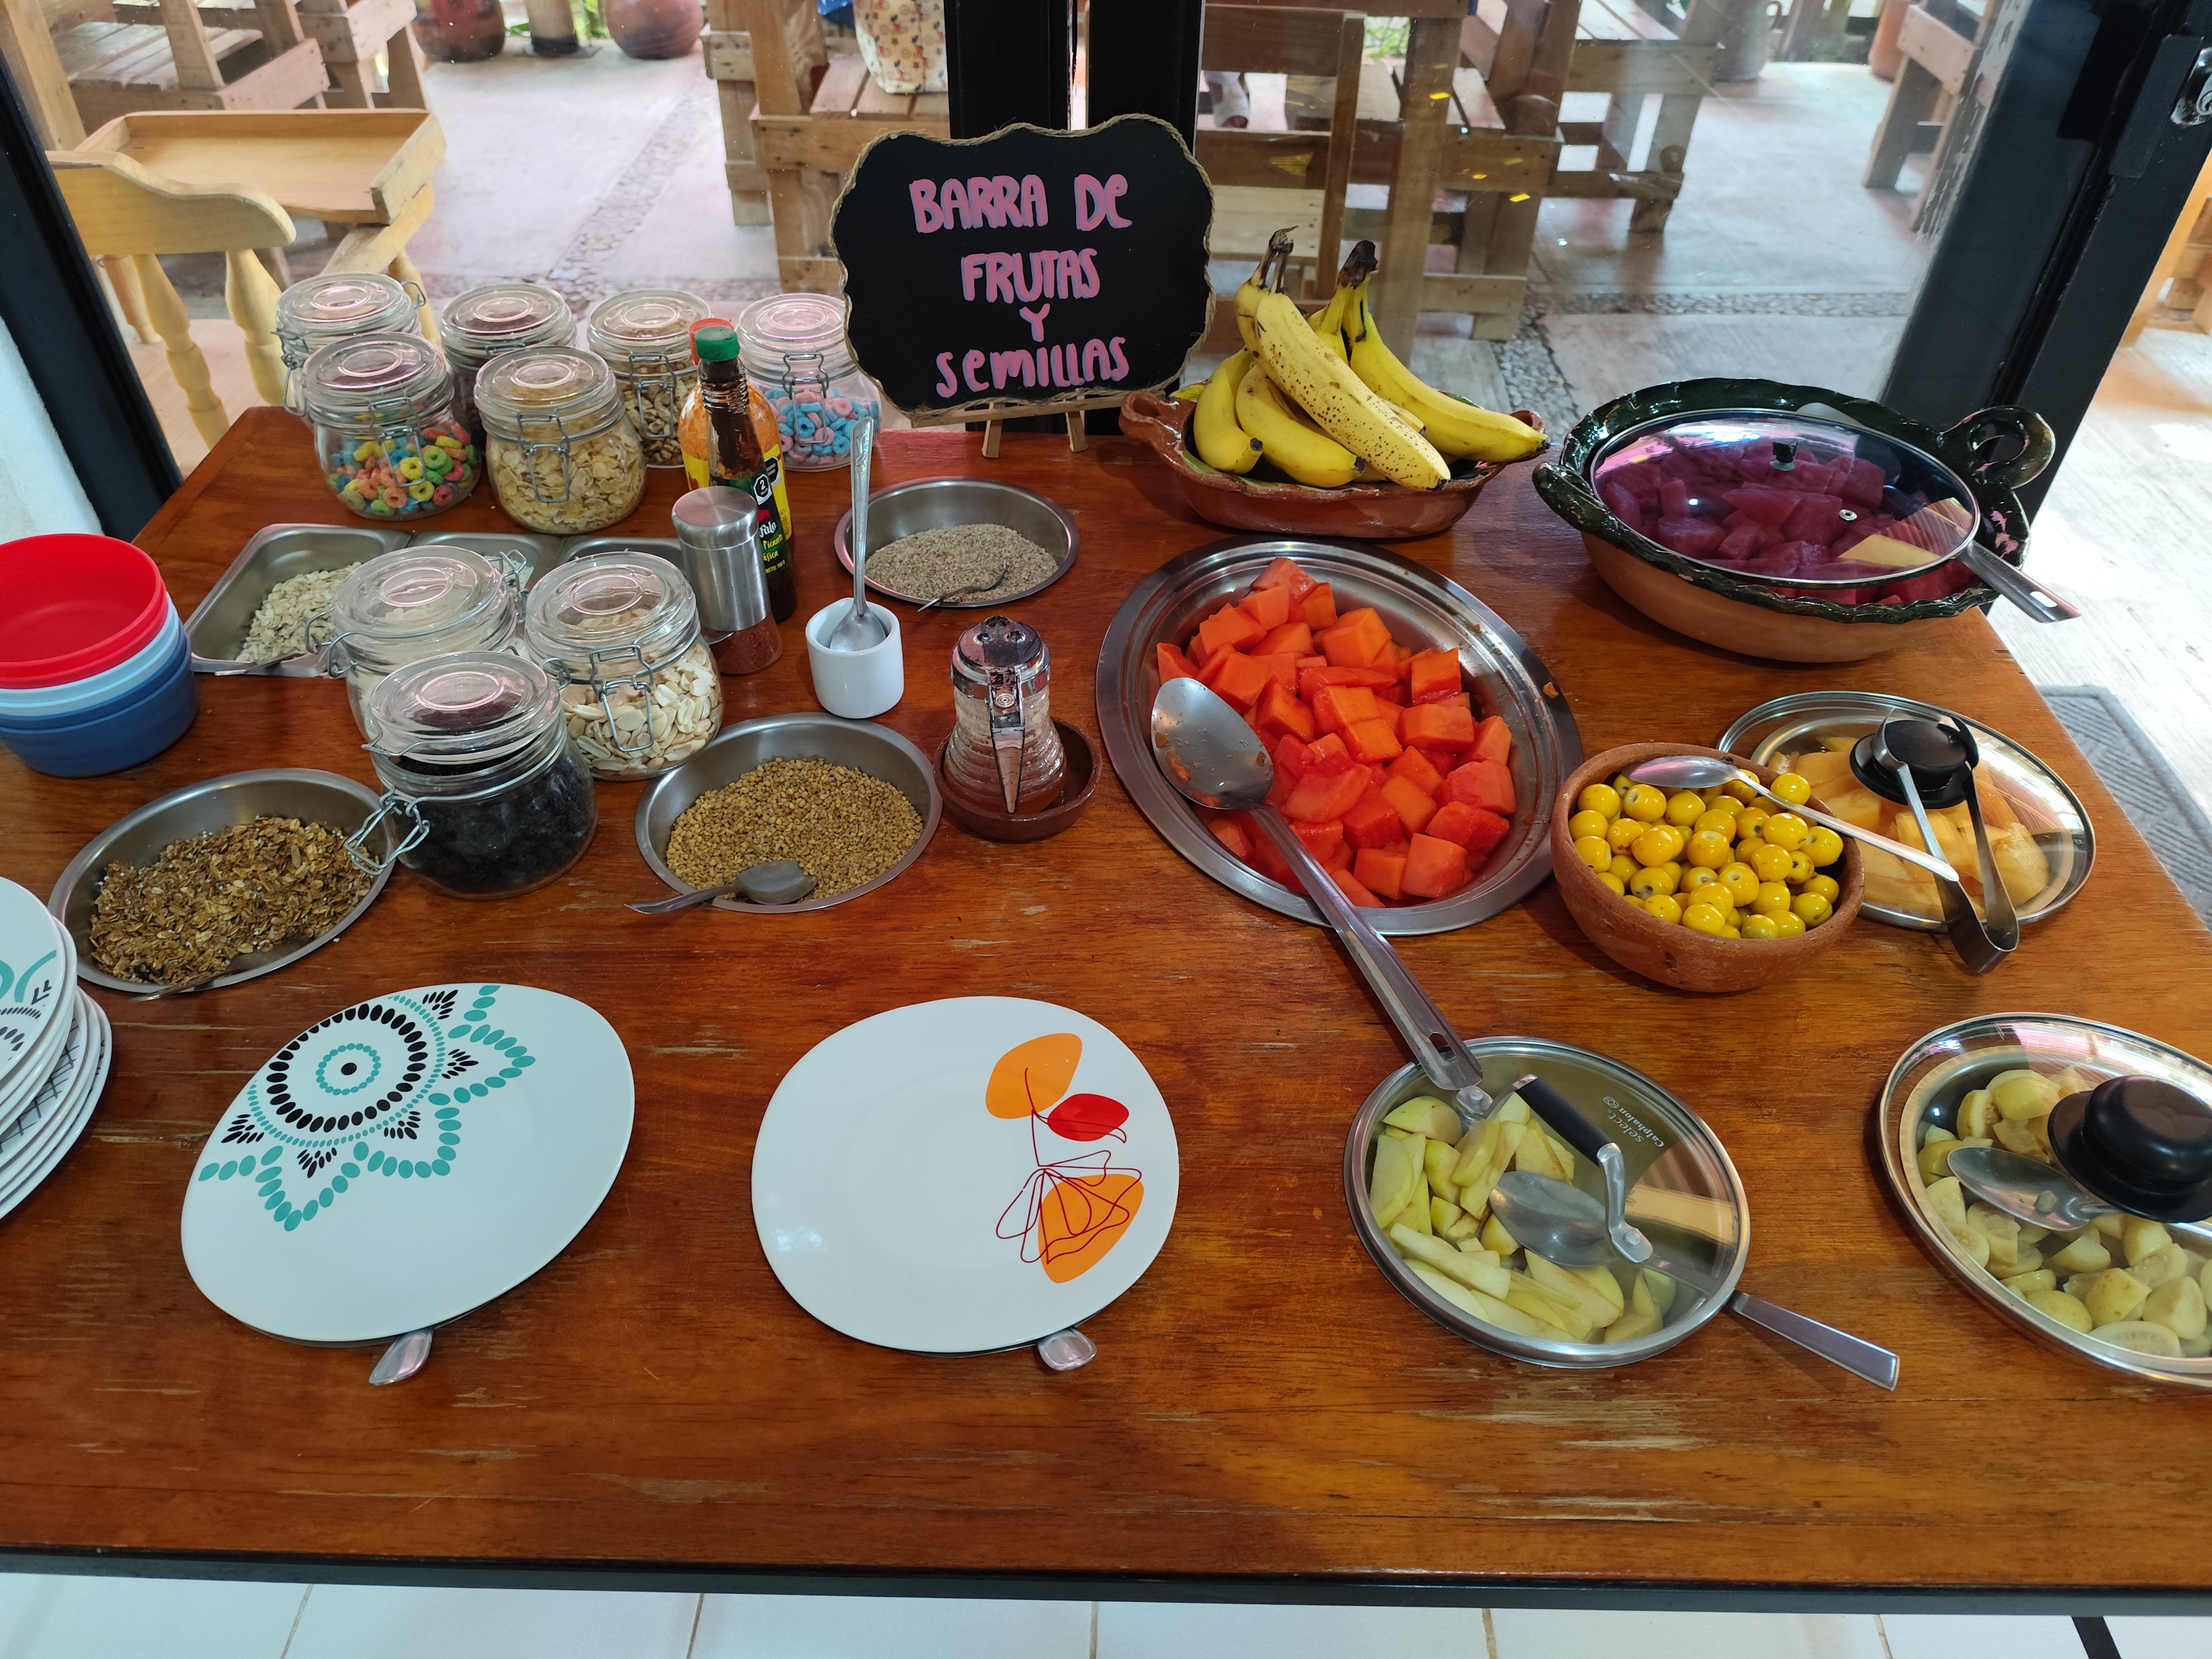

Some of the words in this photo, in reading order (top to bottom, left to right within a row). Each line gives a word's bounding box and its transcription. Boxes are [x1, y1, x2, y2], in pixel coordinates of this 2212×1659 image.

[909, 174, 1049, 233] BARRA
[961, 248, 1101, 304] FRUTAS
[1019, 303, 1051, 343] Y
[760, 479, 766, 491] 2
[759, 521, 776, 538] falo
[762, 550, 779, 563] ásica
[1618, 1108, 1664, 1147] Calphalon
